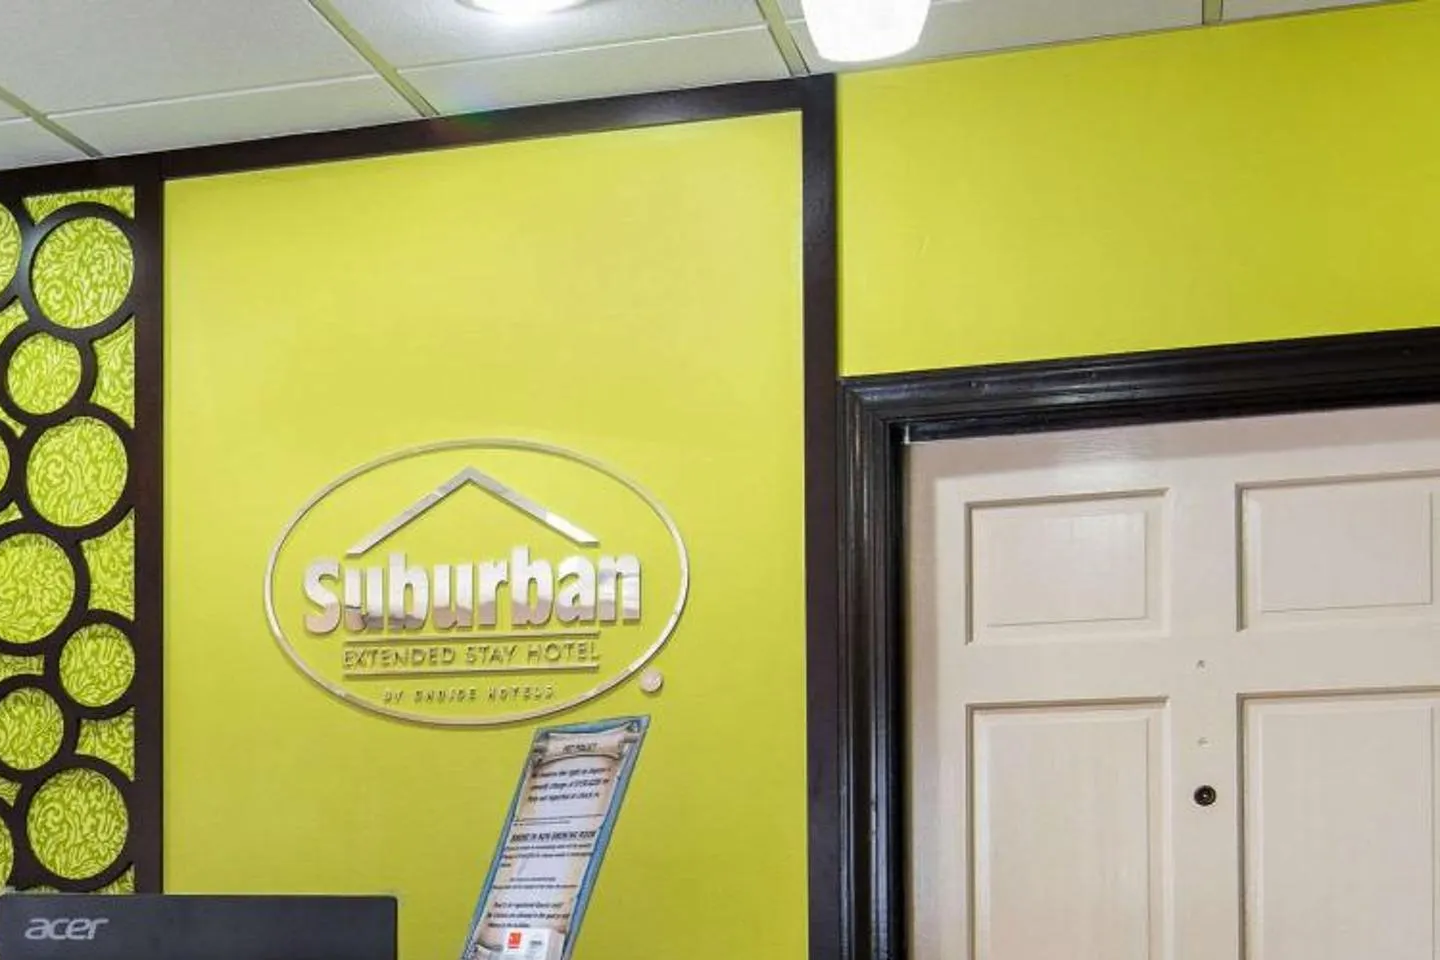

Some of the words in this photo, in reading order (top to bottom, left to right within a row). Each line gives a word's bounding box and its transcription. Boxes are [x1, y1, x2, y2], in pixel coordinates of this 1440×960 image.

[303, 545, 642, 634] Suburban
[343, 647, 456, 670] EXTENDED
[465, 644, 518, 665] STAY
[526, 639, 601, 664] HOTEL
[415, 688, 477, 703] CHOICE
[488, 685, 556, 700] HOTELS
[24, 917, 109, 940] acer
